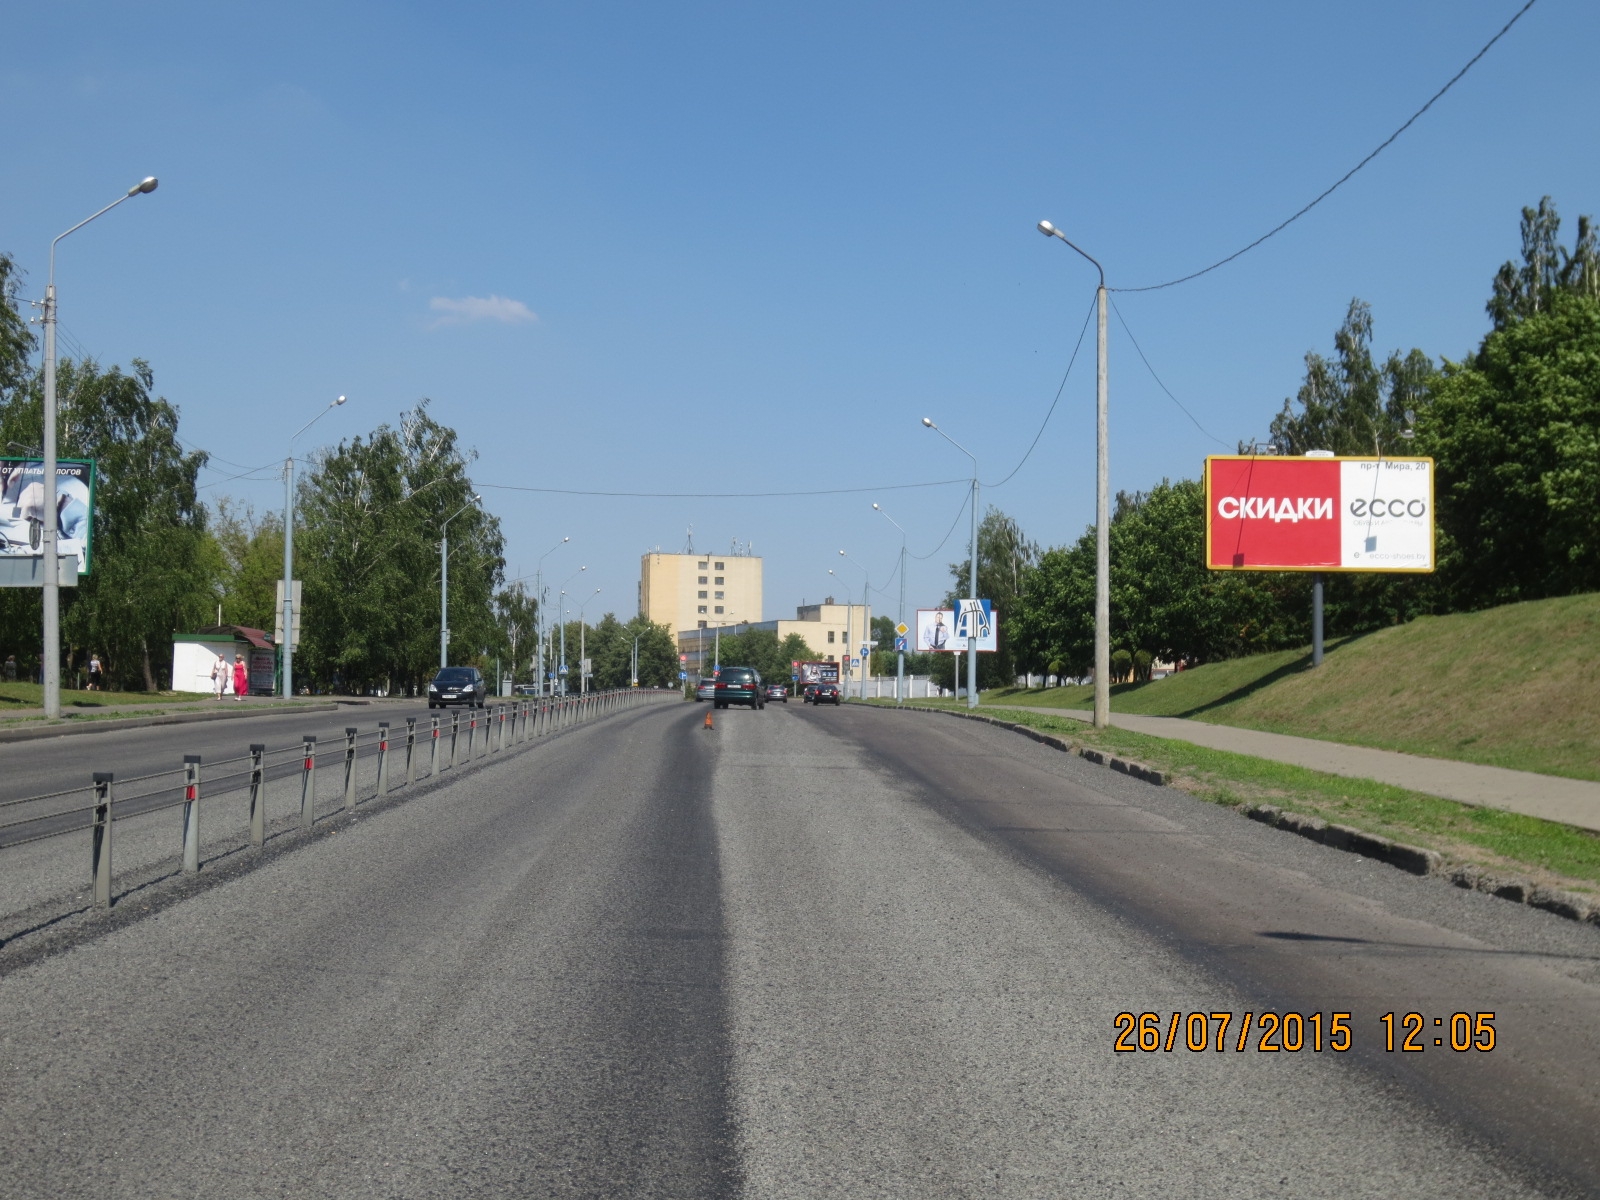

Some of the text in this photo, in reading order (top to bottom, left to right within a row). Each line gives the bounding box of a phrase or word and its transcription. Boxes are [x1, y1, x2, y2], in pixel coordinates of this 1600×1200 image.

[1385, 462, 1412, 471] Мира,
[1416, 462, 1426, 470] 20
[1218, 496, 1333, 523] СКИДКИ
[1350, 498, 1426, 518] ecco
